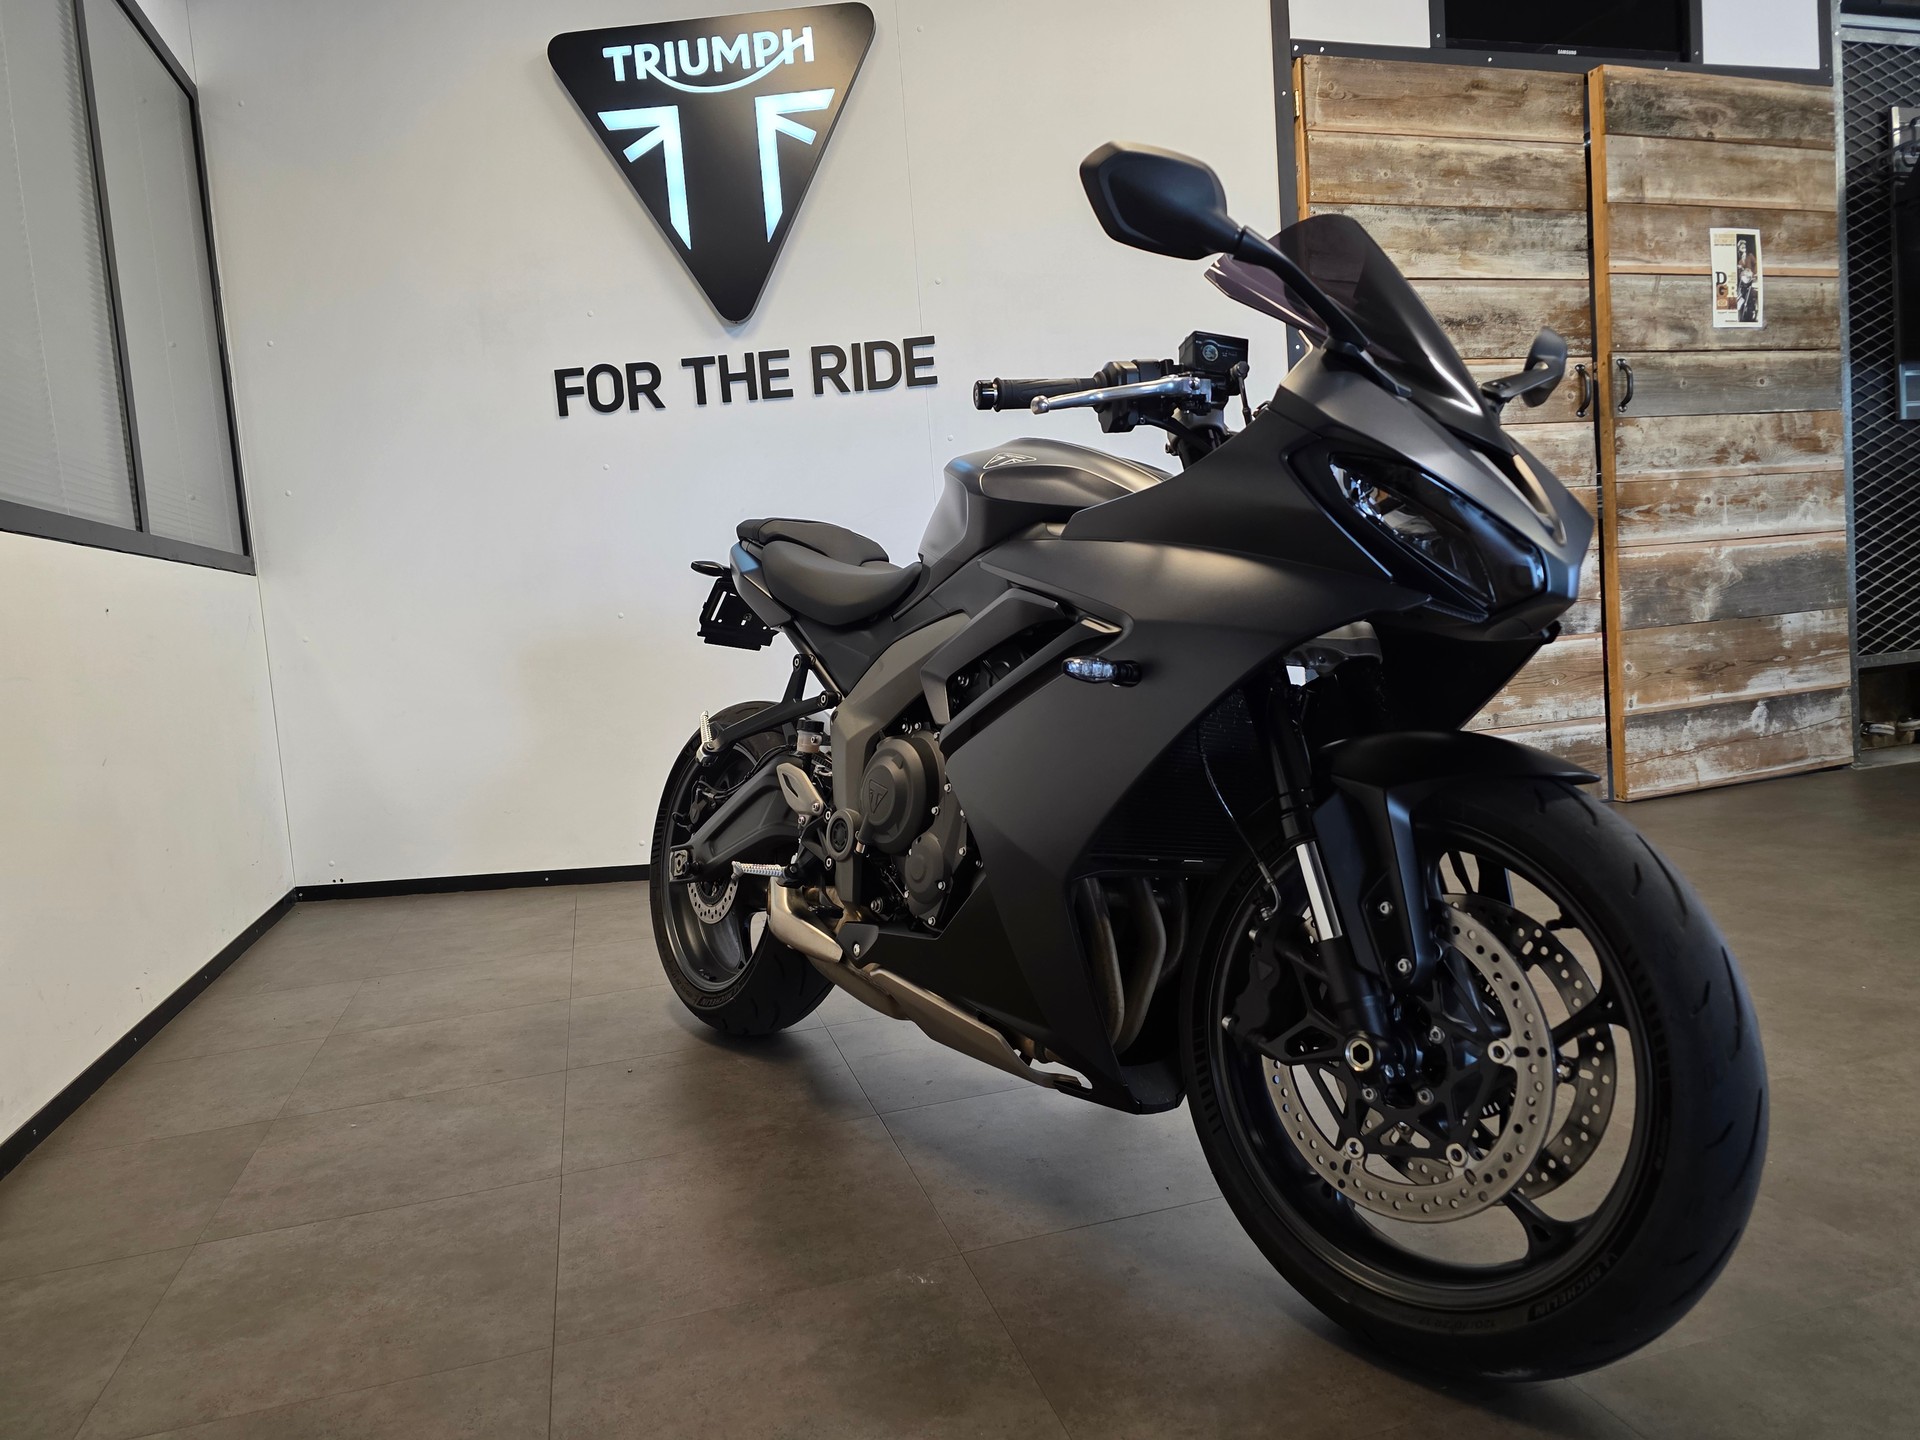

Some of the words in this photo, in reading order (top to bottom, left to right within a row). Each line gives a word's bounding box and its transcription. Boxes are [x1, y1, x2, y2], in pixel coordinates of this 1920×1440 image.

[602, 26, 814, 93] TRIUMPH
[553, 361, 666, 417] FOR
[681, 349, 793, 405] THE
[810, 335, 939, 395] RIDE
[1533, 1266, 1603, 1316] MICHELIN
